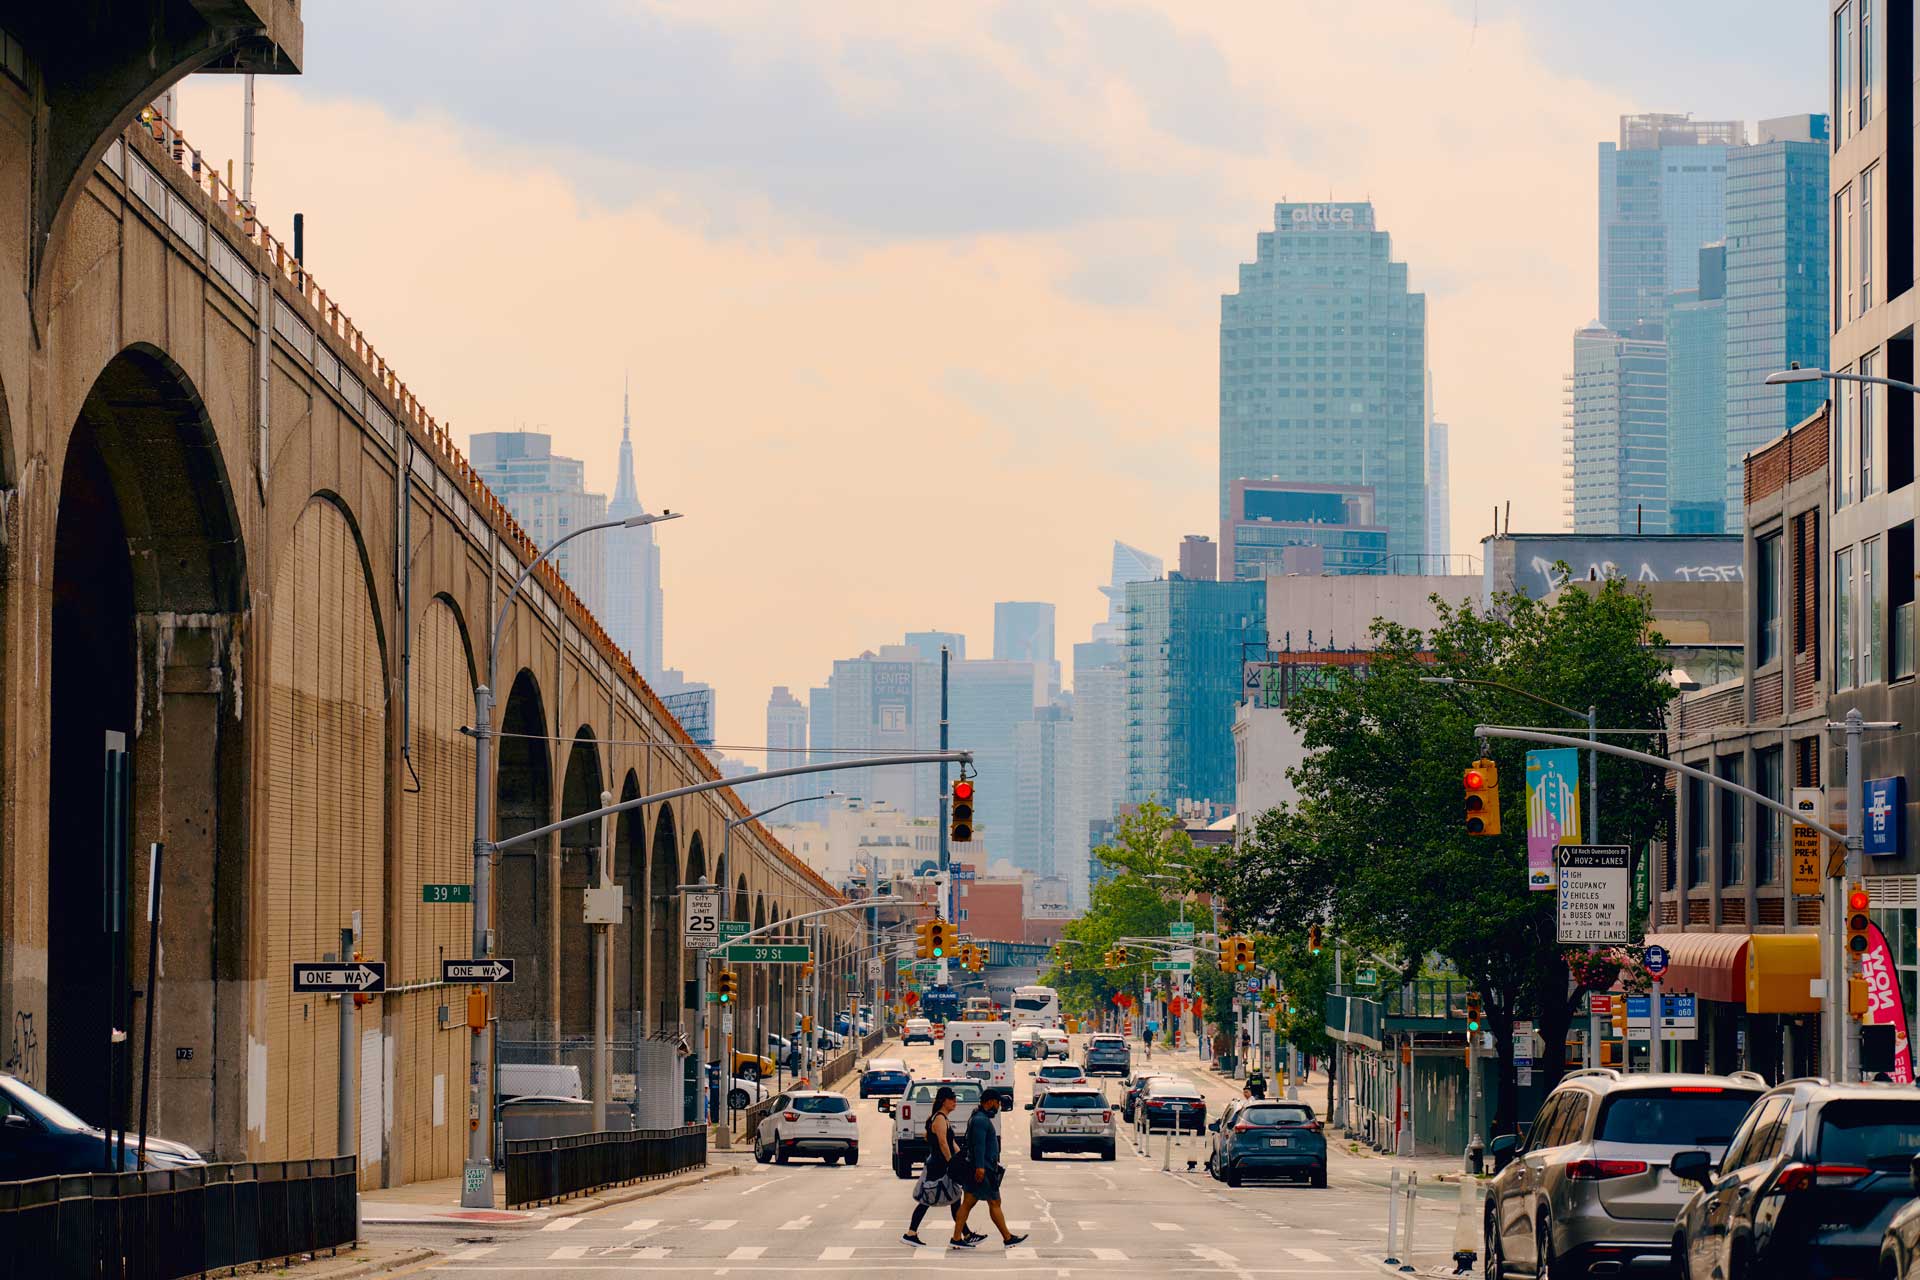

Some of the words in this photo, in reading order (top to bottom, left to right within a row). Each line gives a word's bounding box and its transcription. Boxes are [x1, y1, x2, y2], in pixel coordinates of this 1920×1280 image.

[1292, 203, 1354, 224] altice
[875, 672, 910, 684] CENTER
[1547, 760, 1558, 848] SUNNYSID
[1795, 827, 1817, 838] FREE
[1795, 849, 1817, 857] PRE-K
[1799, 865, 1813, 875] 3-K
[433, 886, 448, 901] 39
[1561, 901, 1569, 910] 2
[690, 916, 715, 931] 25
[726, 924, 745, 932] ROUTE
[1560, 930, 1573, 938] USE
[1576, 930, 1581, 939] 2
[1585, 930, 1601, 939] LEFT
[1604, 931, 1626, 940] LANES
[755, 949, 768, 959] 39
[771, 949, 782, 959] St
[452, 966, 473, 977] ONE
[482, 966, 503, 977] WAY
[306, 971, 332, 984] ONE
[344, 971, 371, 984] WAY
[177, 1049, 193, 1059] 173
